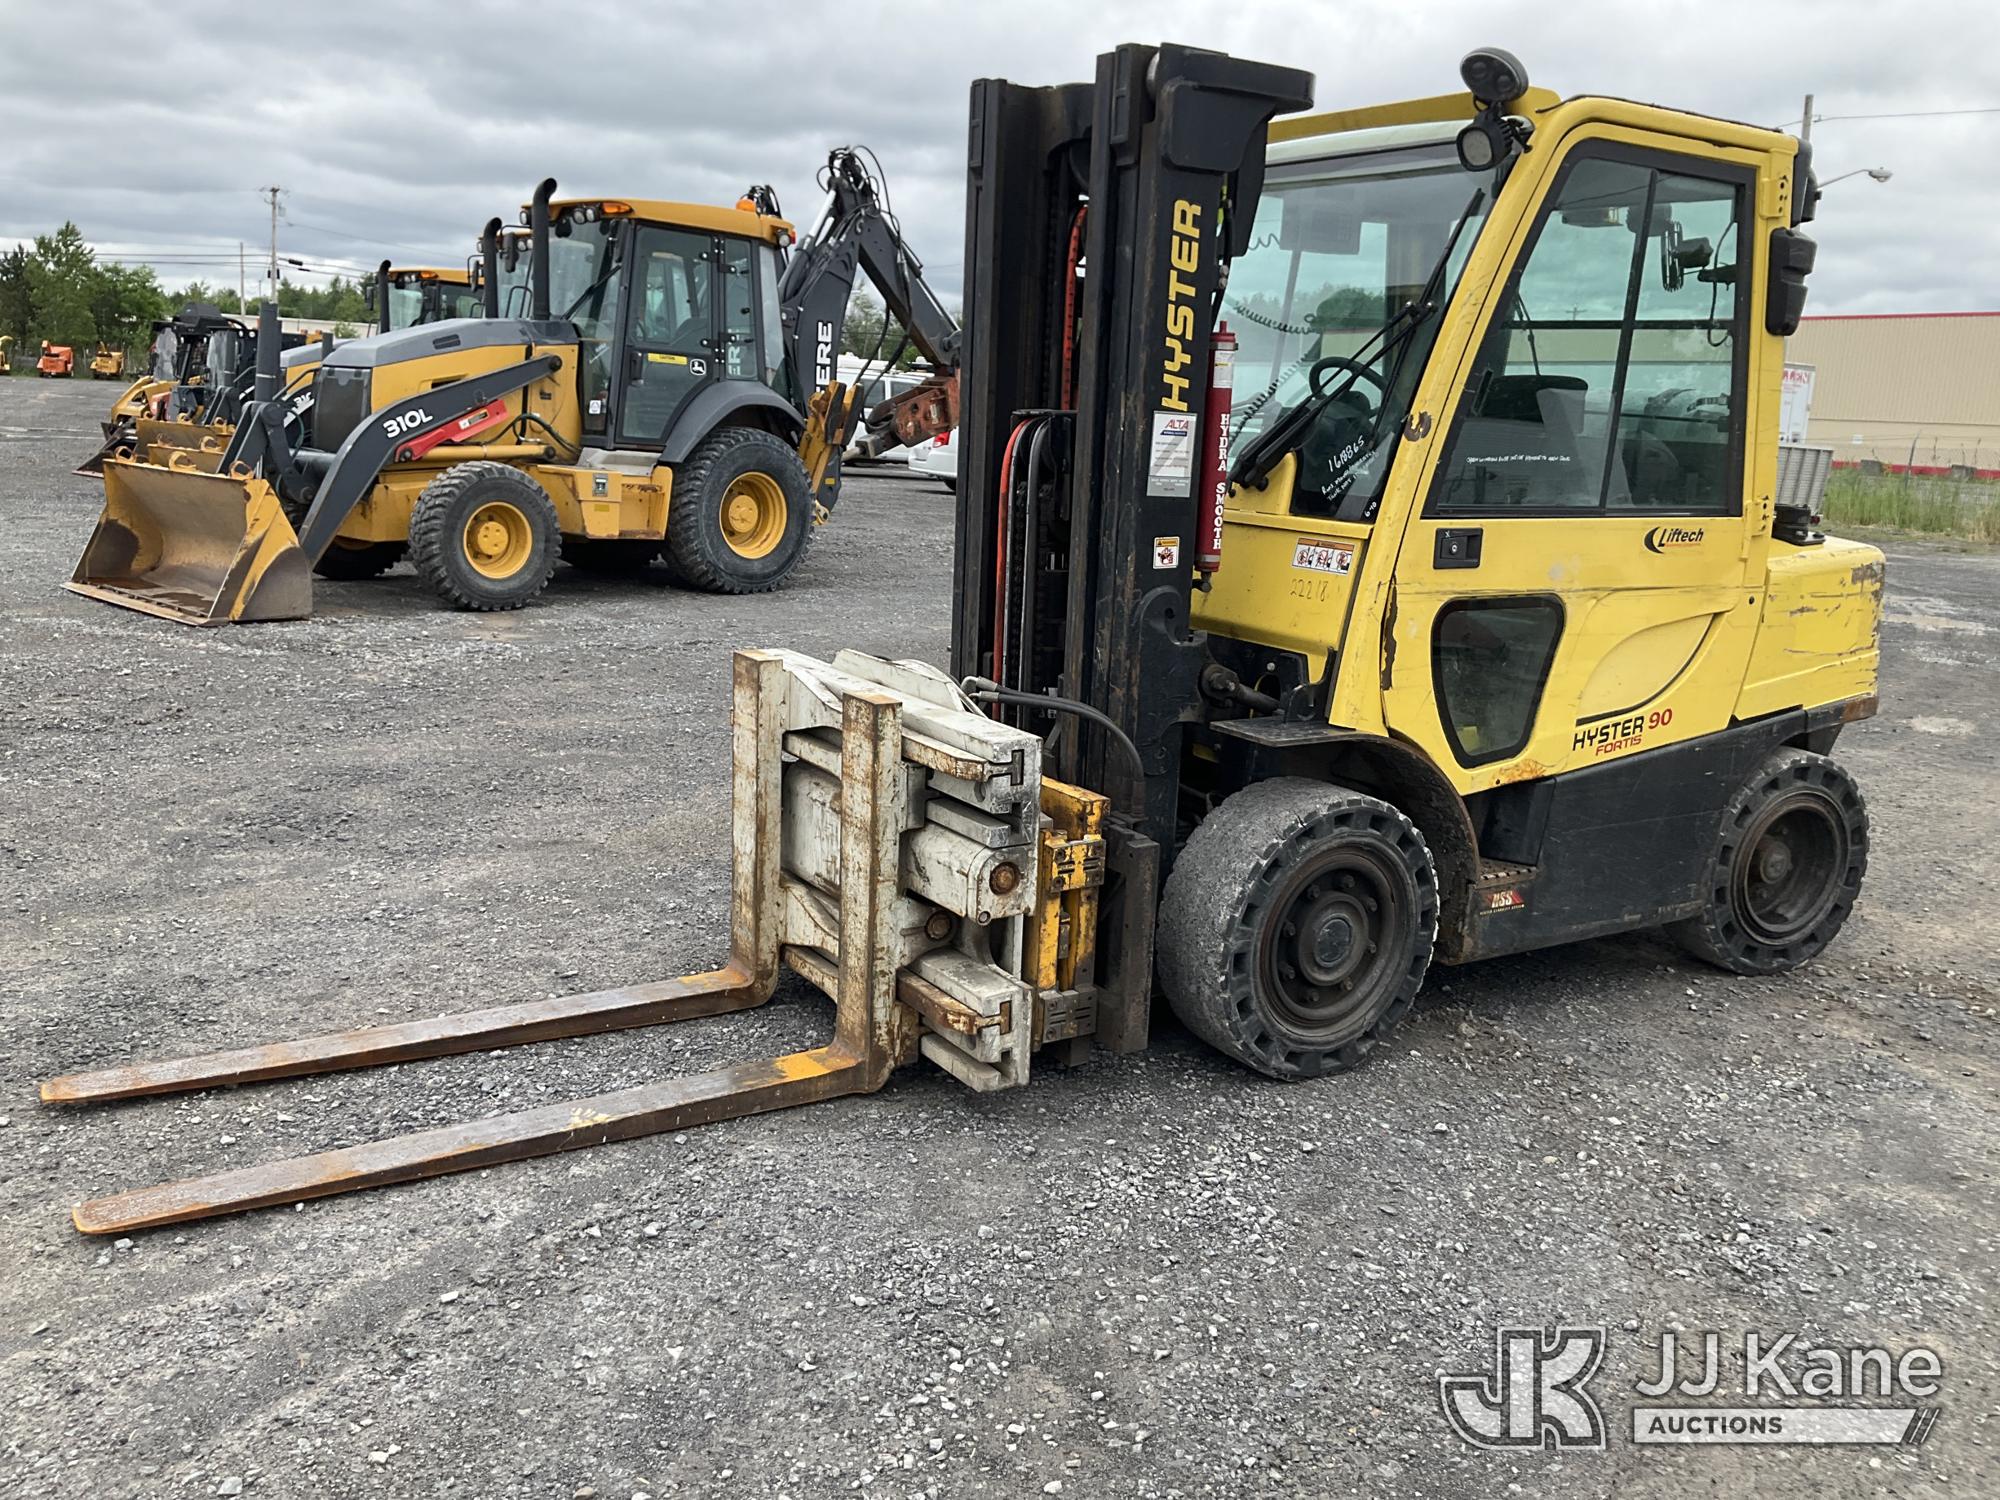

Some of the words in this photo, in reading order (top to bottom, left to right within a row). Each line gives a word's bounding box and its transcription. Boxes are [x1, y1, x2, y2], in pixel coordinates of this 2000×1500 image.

[1161, 199, 1202, 412] HYSTER
[382, 408, 434, 439] 310L
[1165, 419, 1190, 430] ALTA
[1216, 413, 1230, 472] HYDRA
[1212, 482, 1226, 550] SMOOTH
[1657, 527, 1705, 548] Liftech
[1572, 715, 1645, 752] HYSTER
[1648, 707, 1673, 730] 90
[1595, 734, 1643, 757] FORTIS
